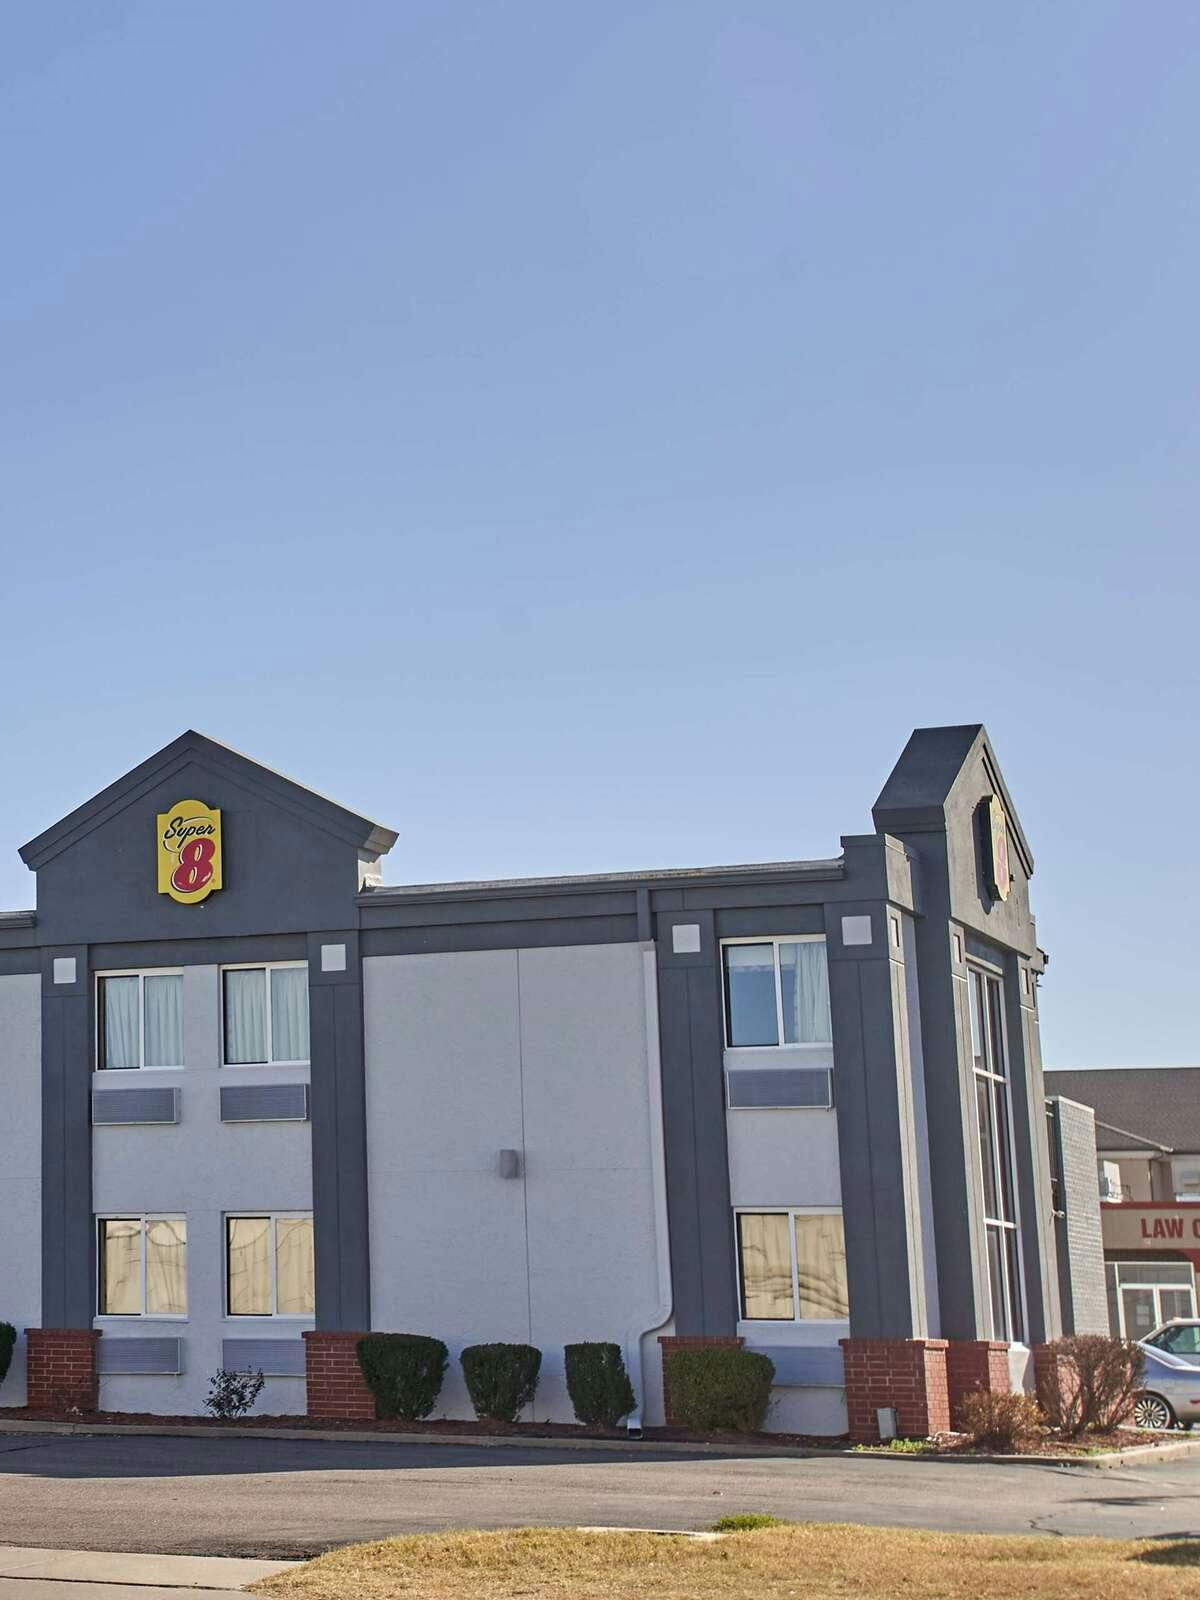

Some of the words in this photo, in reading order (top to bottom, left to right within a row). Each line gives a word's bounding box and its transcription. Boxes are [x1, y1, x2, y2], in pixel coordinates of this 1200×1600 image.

[164, 816, 215, 848] Super
[170, 838, 215, 893] 8
[1140, 1218, 1184, 1239] LAW
